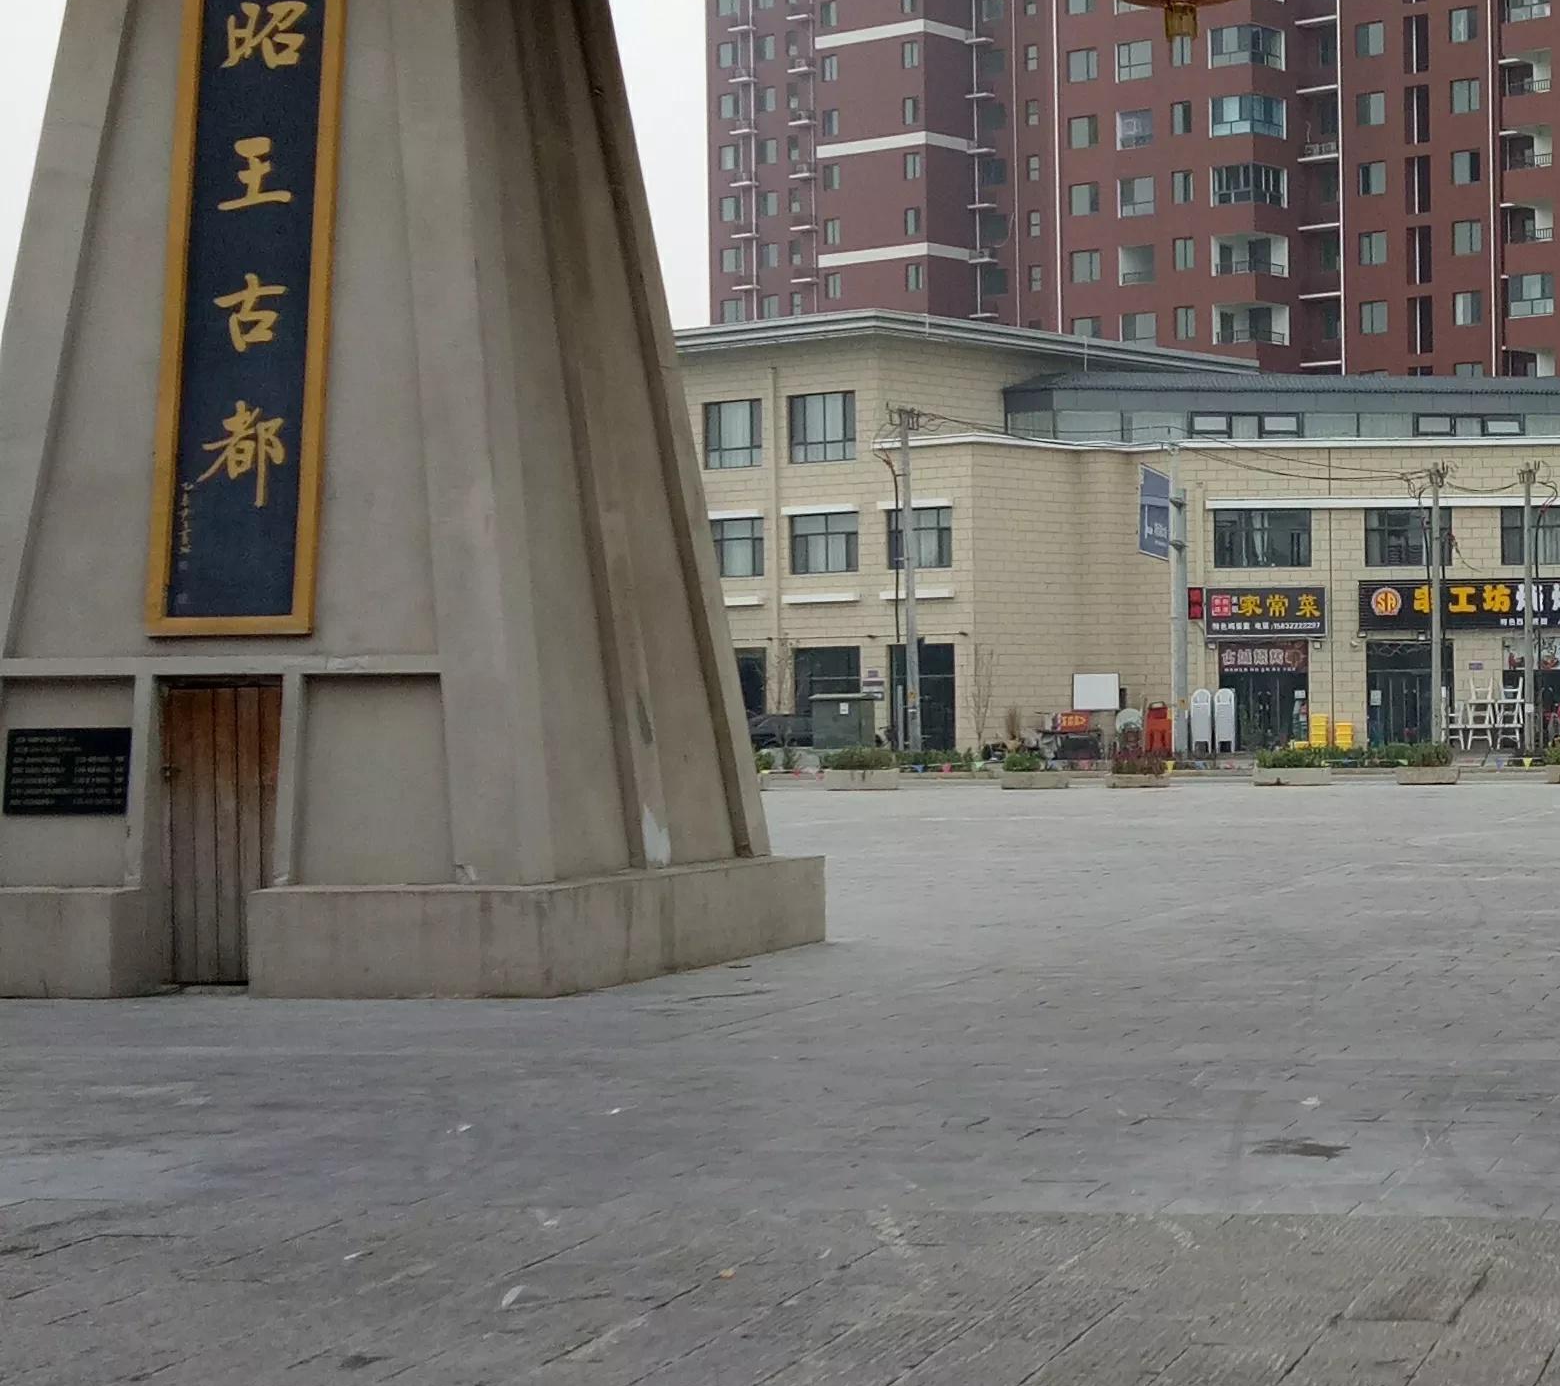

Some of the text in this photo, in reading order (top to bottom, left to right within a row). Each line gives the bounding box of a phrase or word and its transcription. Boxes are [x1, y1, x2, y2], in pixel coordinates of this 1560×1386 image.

[197, 0, 309, 506] 昭王古都
[1239, 593, 1322, 617] 家常菜
